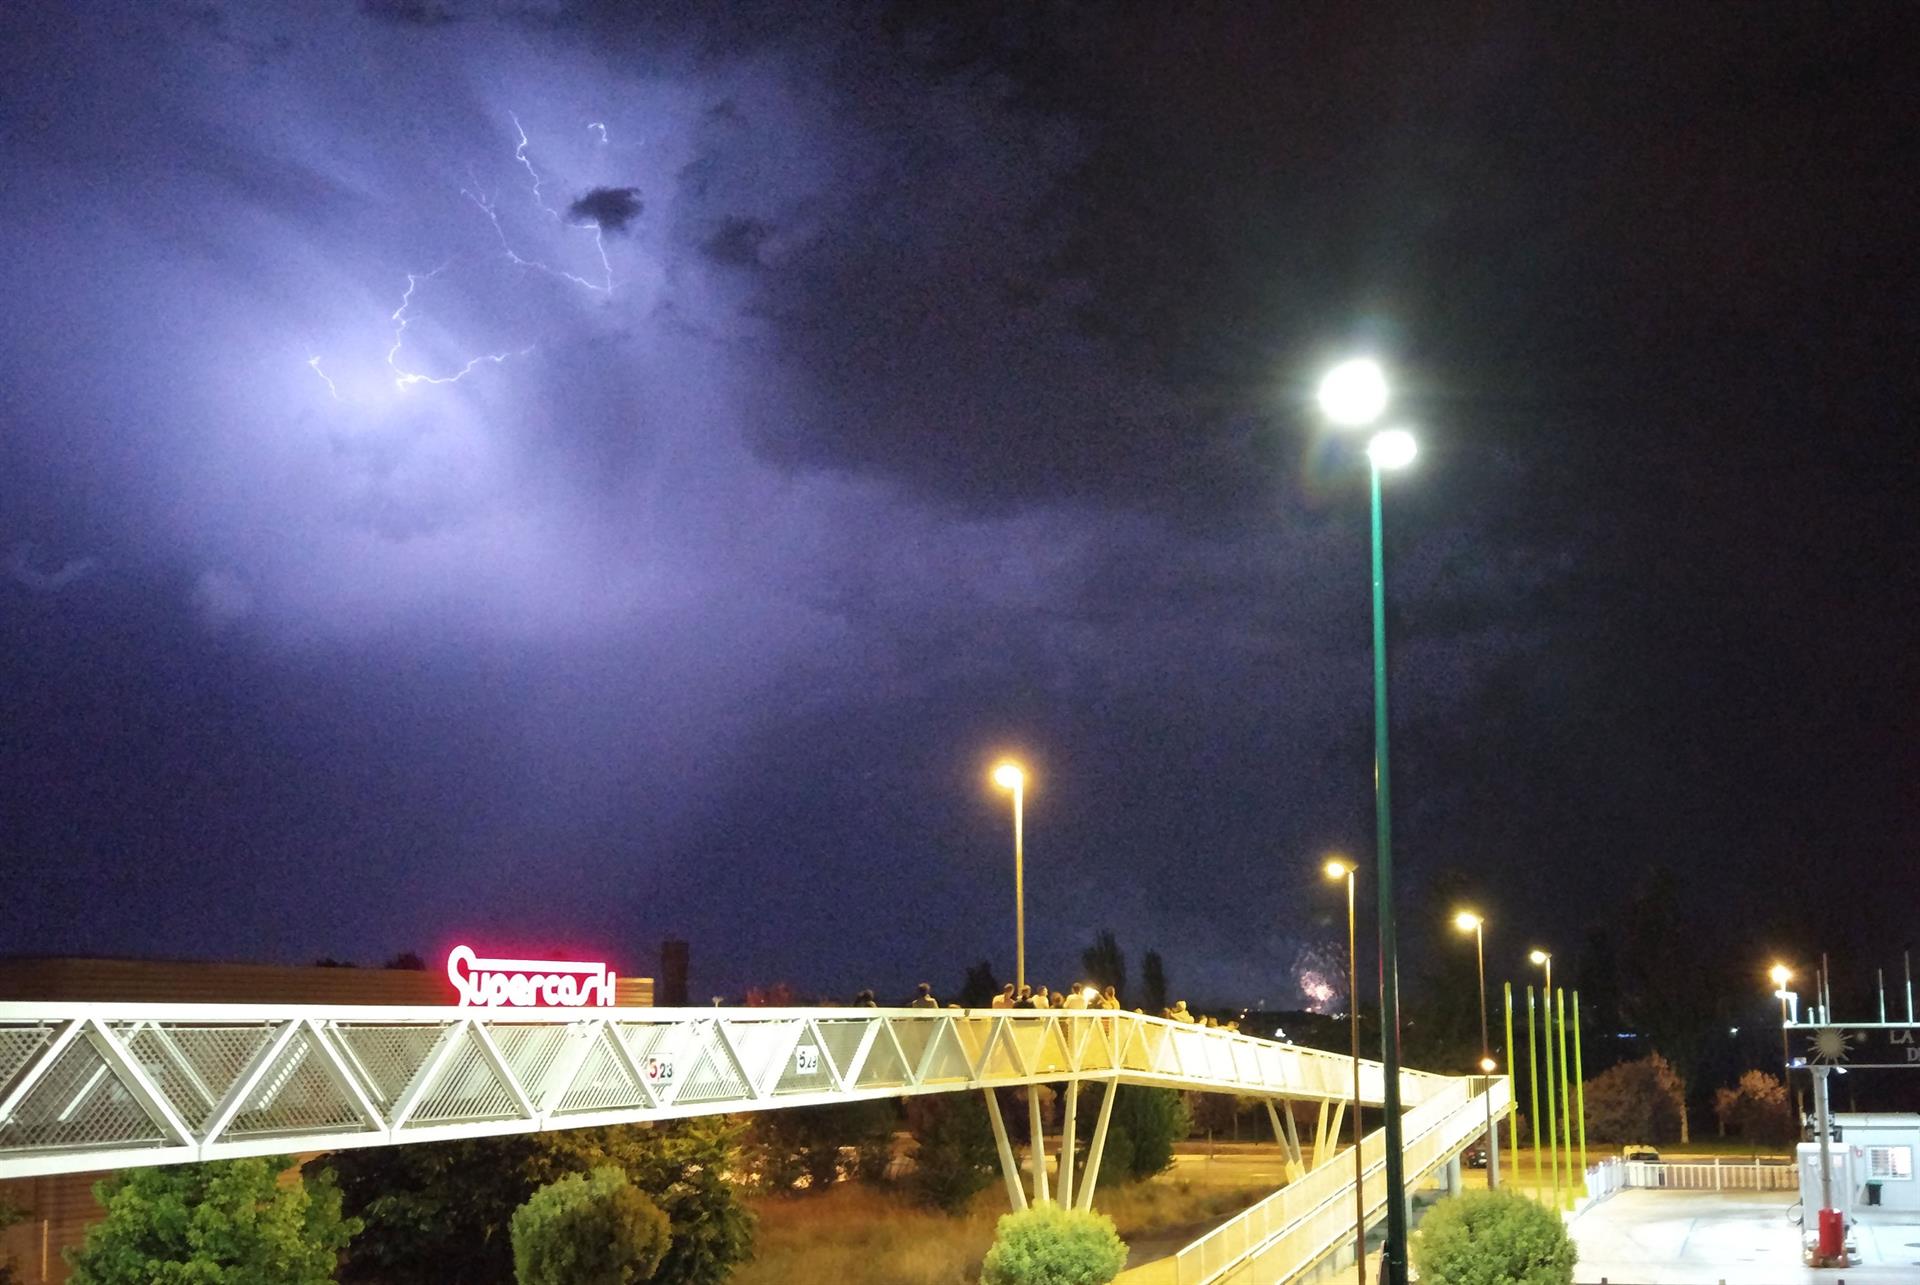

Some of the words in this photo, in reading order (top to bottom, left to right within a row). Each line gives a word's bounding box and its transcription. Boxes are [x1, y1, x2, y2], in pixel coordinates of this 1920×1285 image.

[1890, 1030, 1914, 1044] LA
[1907, 1048, 1920, 1061] D
[649, 1058, 672, 1081] 5,23
